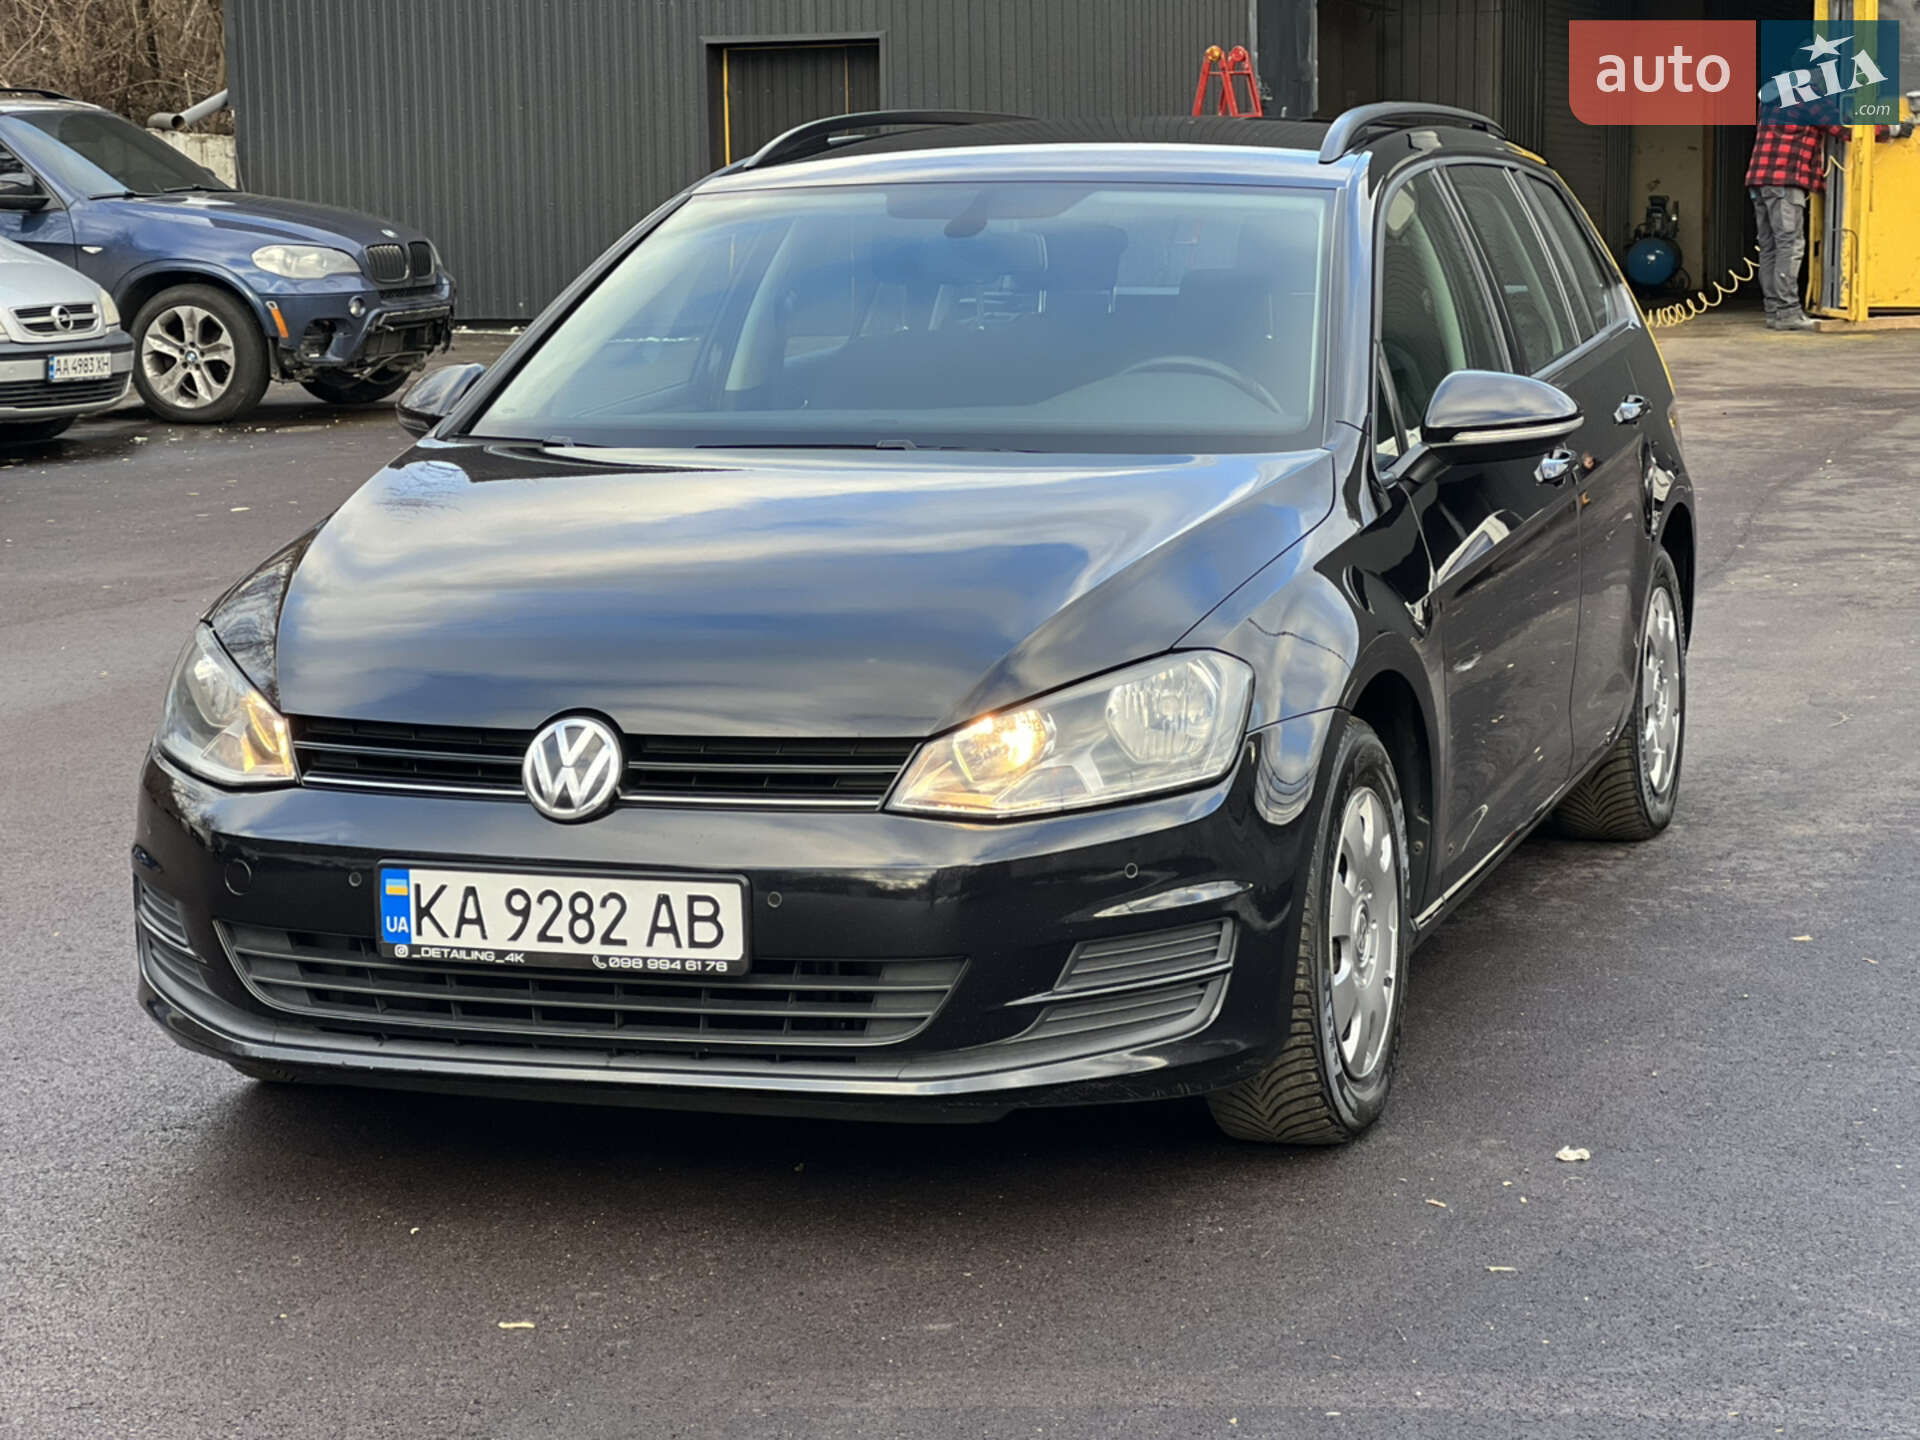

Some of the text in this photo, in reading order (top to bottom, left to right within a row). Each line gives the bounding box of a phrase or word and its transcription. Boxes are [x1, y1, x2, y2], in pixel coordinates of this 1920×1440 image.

[56, 359, 70, 375] AA
[71, 356, 94, 374] 4983
[96, 356, 110, 373] XH
[386, 916, 409, 933] UA
[414, 883, 724, 949] KA 9282 AB
